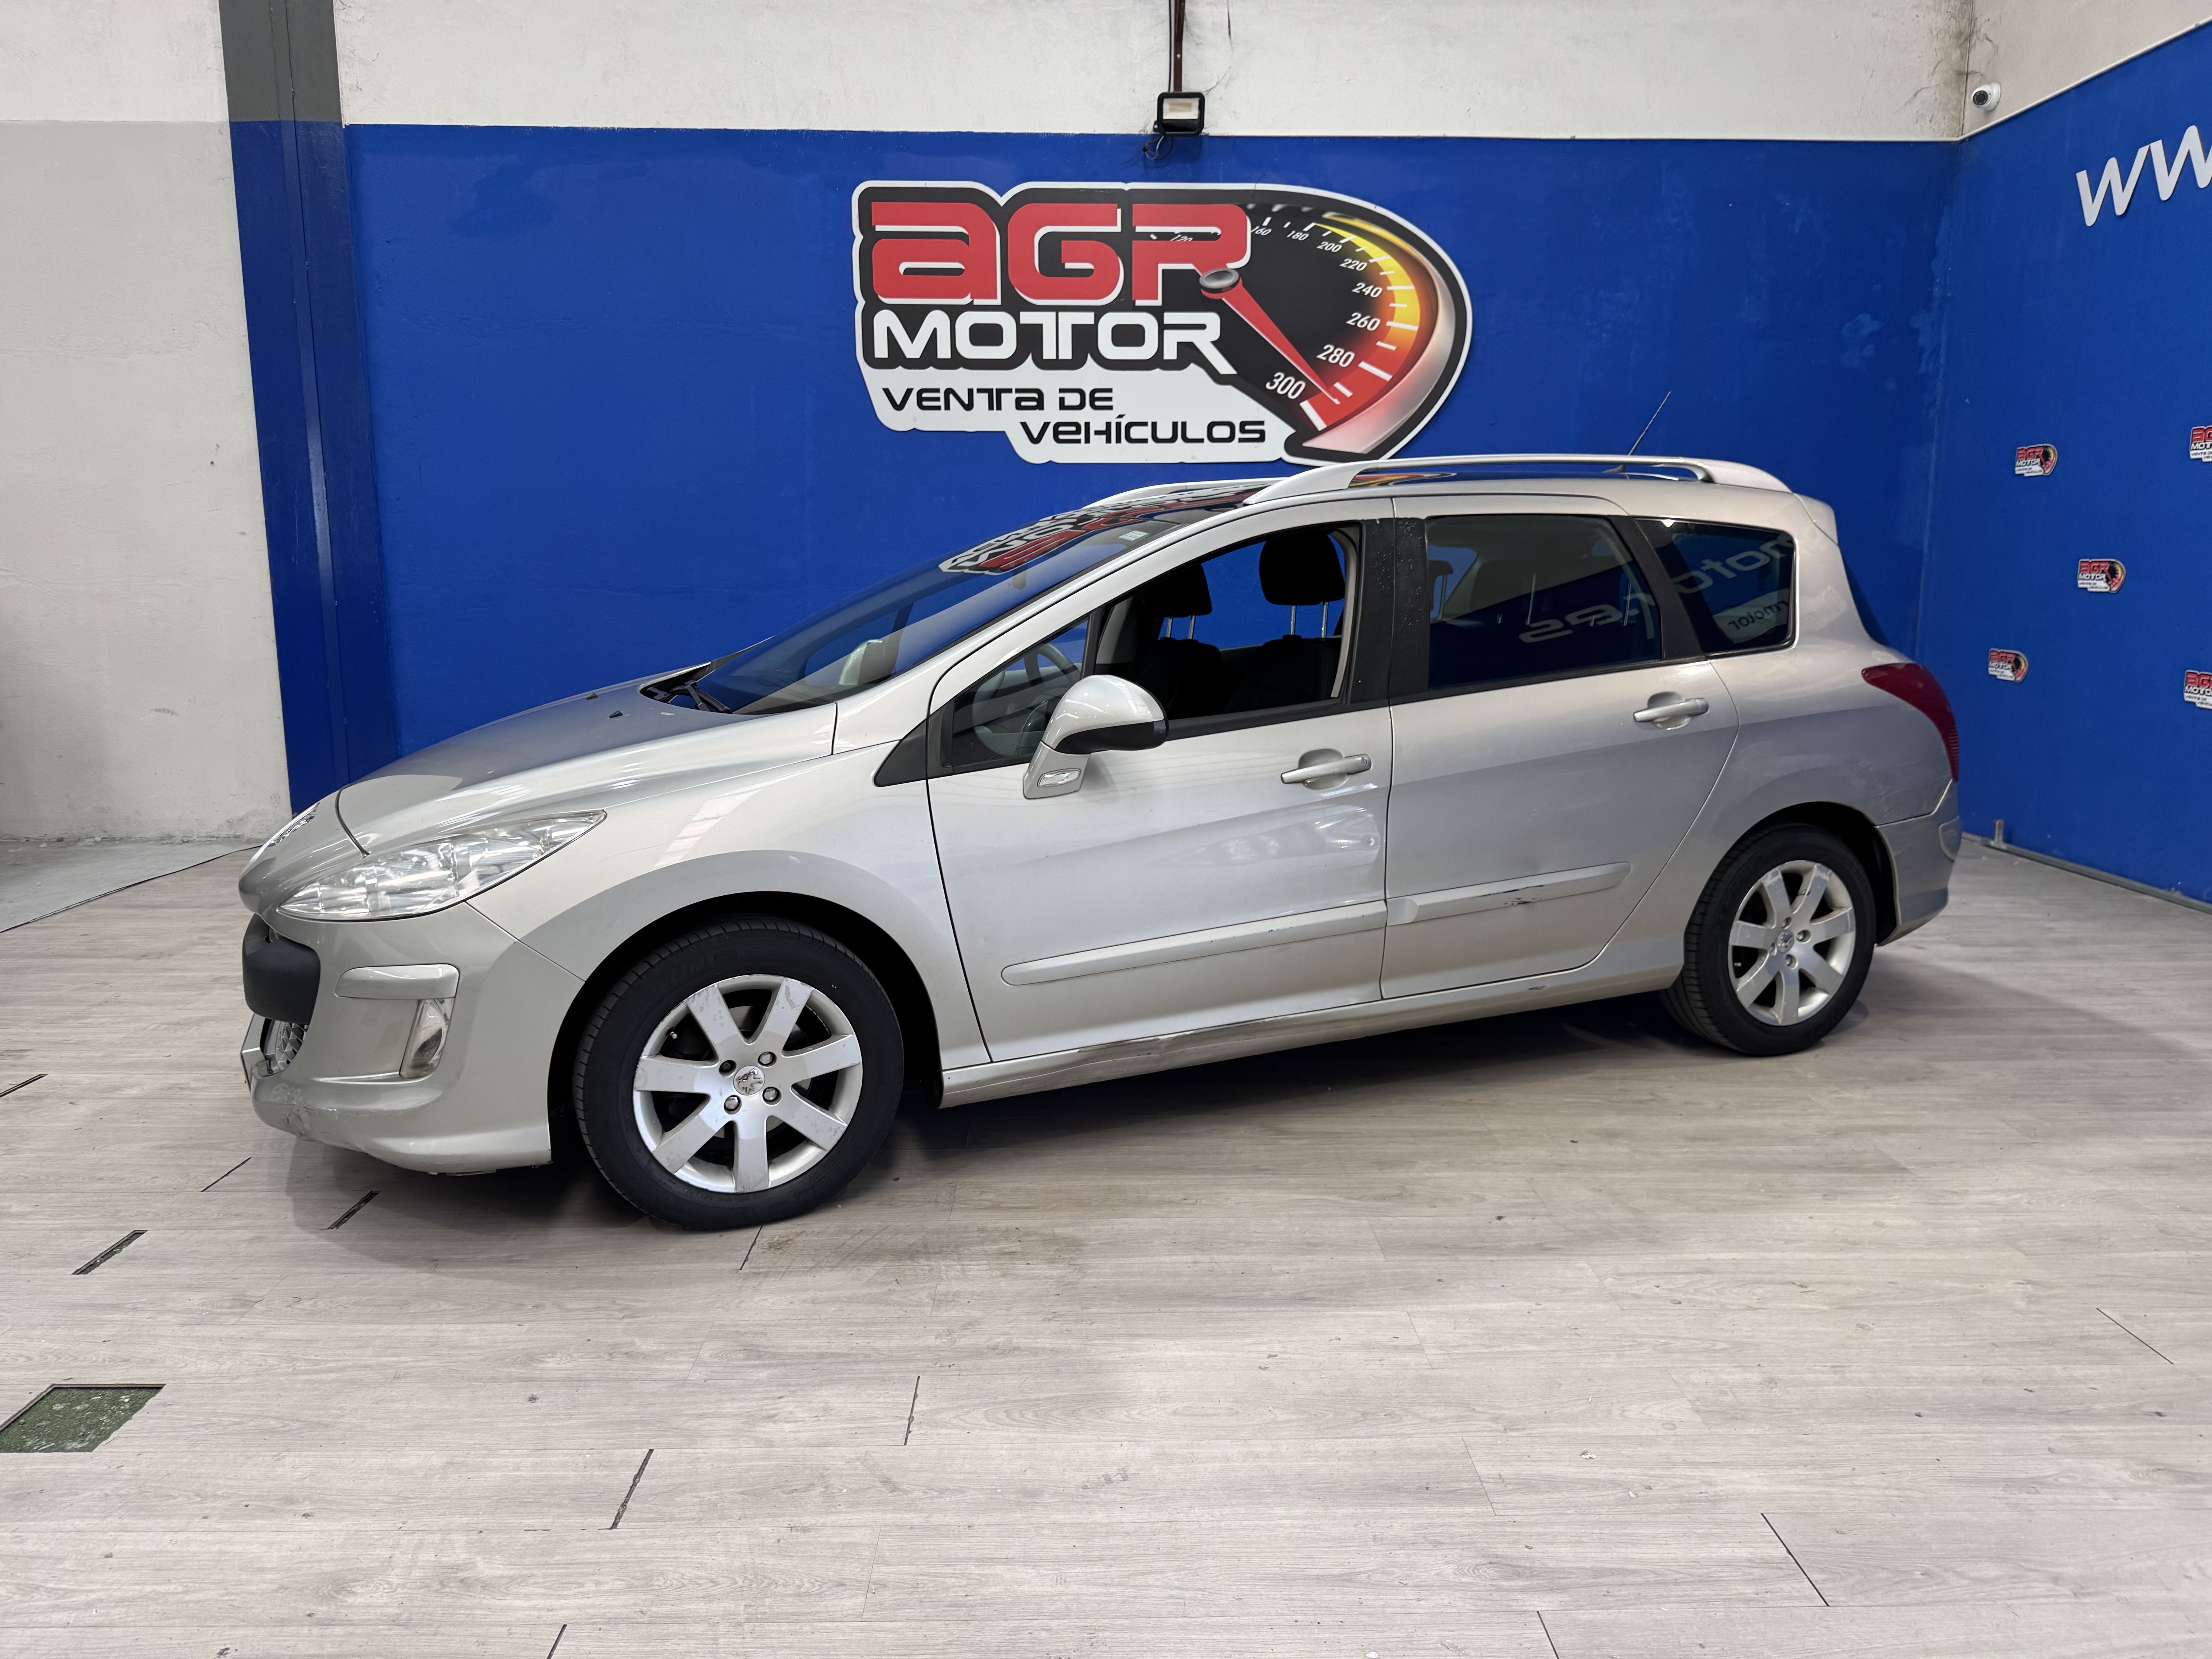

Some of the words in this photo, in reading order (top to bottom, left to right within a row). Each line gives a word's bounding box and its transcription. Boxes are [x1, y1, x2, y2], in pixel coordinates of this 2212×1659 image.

[1251, 226, 1272, 235] 160
[1287, 230, 1309, 240] 180
[1316, 241, 1342, 252] 200
[1340, 258, 1368, 271] 220
[1352, 282, 1383, 298] 240
[1346, 312, 1381, 331] 260
[873, 310, 1237, 374] MOTOR
[1316, 344, 1355, 368] 280
[1265, 372, 1306, 399] 300
[1059, 388, 1113, 411] DE
[2185, 685, 2212, 696] MOTO
